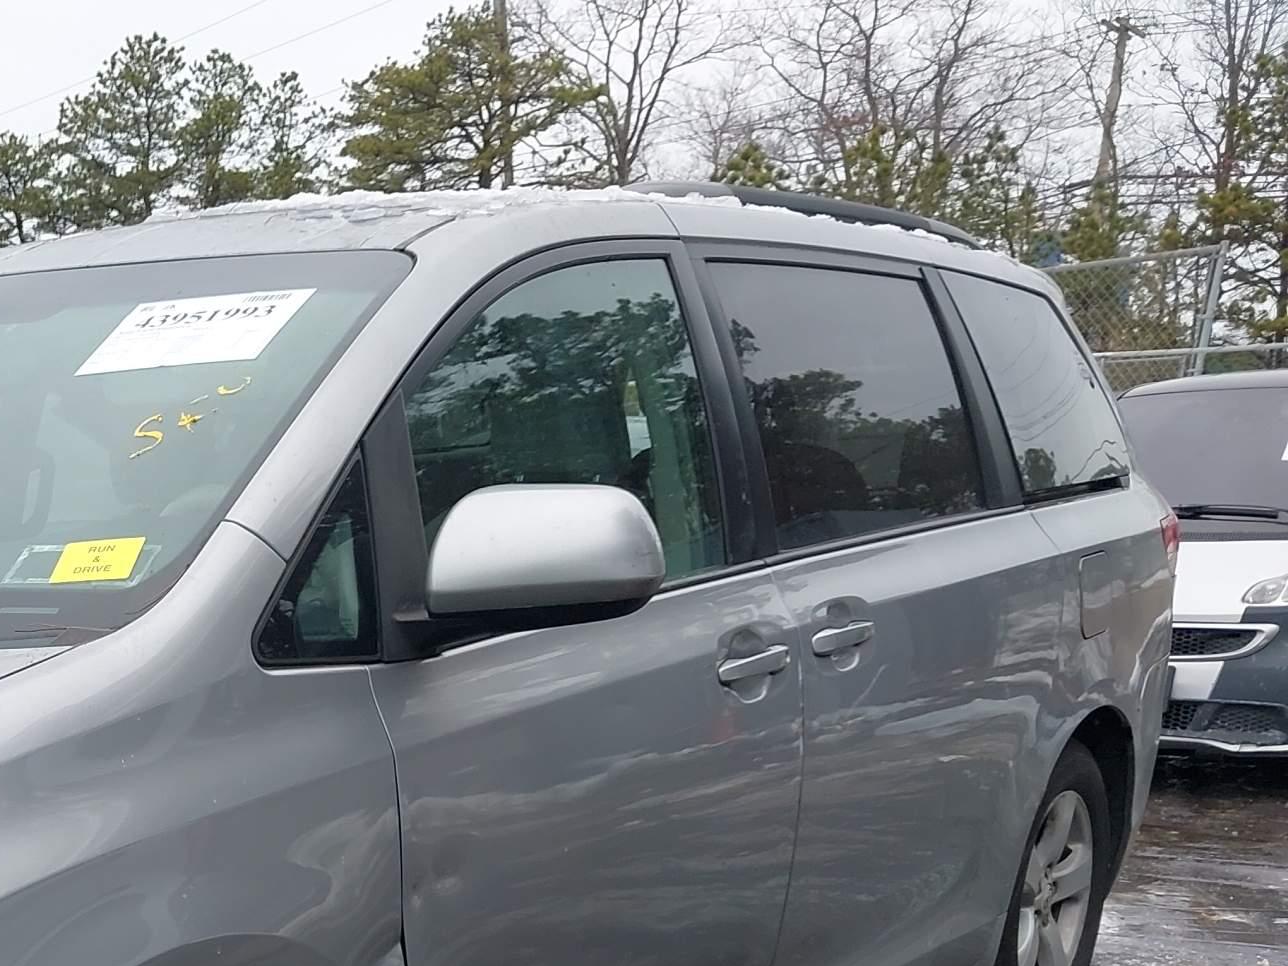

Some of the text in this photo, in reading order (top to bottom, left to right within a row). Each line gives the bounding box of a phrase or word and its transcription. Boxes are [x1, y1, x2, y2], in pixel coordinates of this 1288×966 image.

[135, 305, 277, 329] 43951993
[88, 544, 116, 553] RUN
[73, 564, 112, 574] DRIVE
